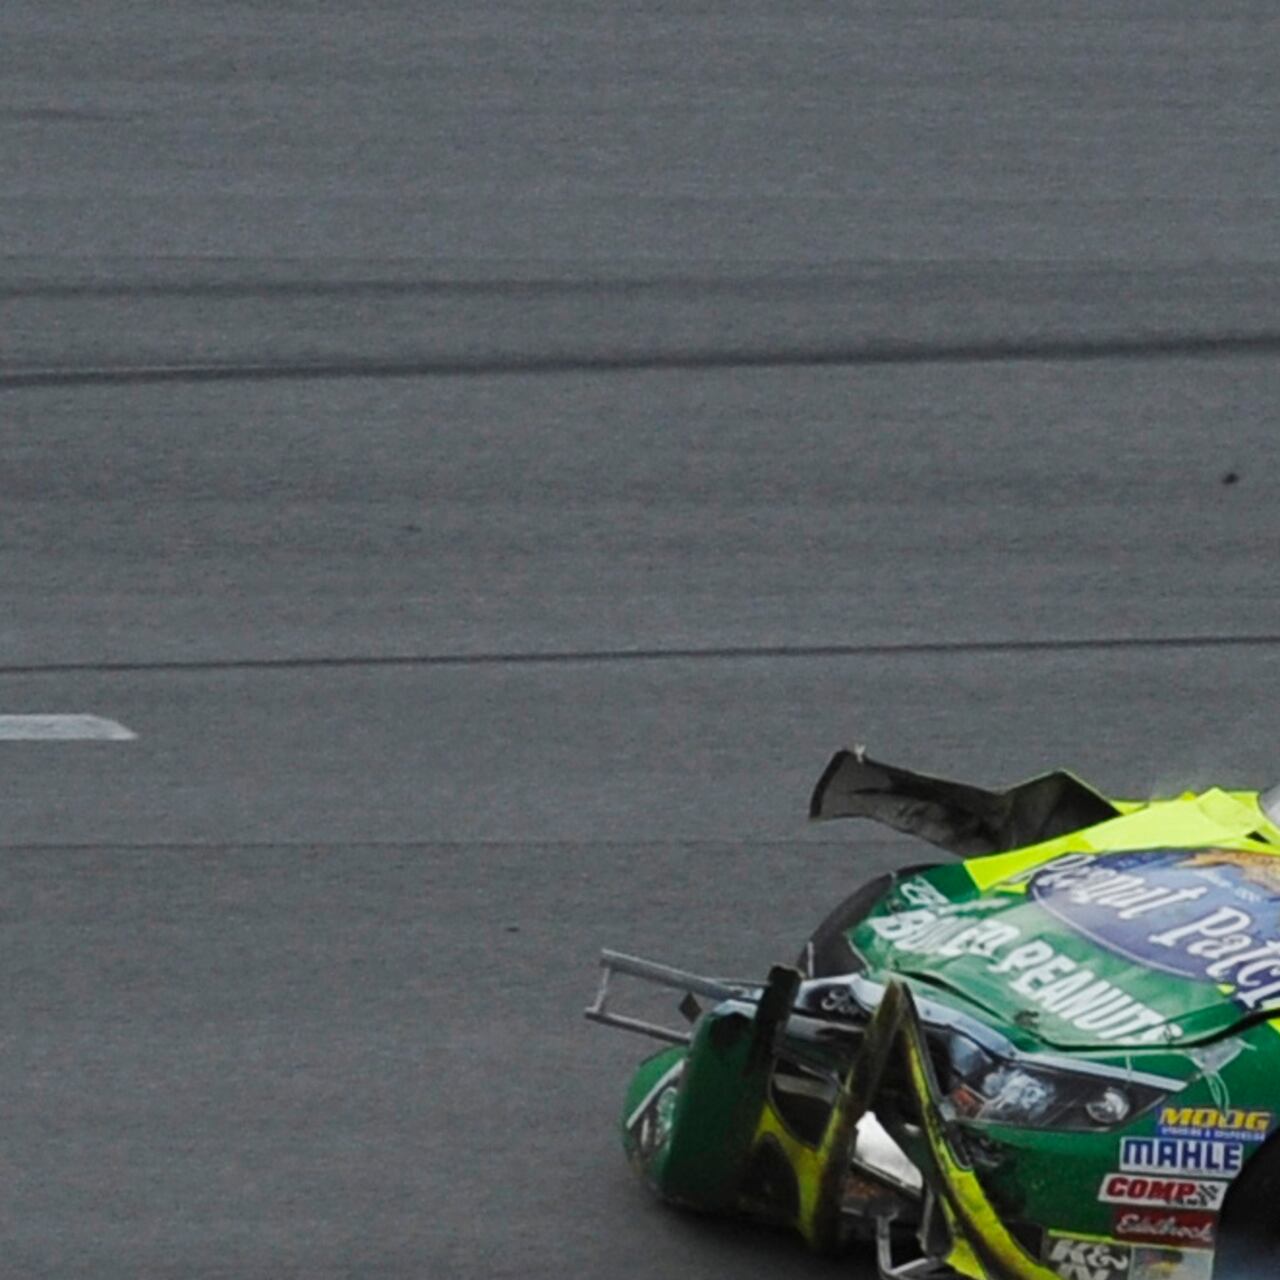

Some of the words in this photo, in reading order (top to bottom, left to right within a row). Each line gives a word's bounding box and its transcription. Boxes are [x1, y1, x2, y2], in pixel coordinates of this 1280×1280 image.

[1003, 934, 1184, 1045] PEANUTS
[1159, 1106, 1271, 1131] MOOG
[1122, 1139, 1242, 1171] MAHLE
[1105, 1175, 1196, 1202] COMP
